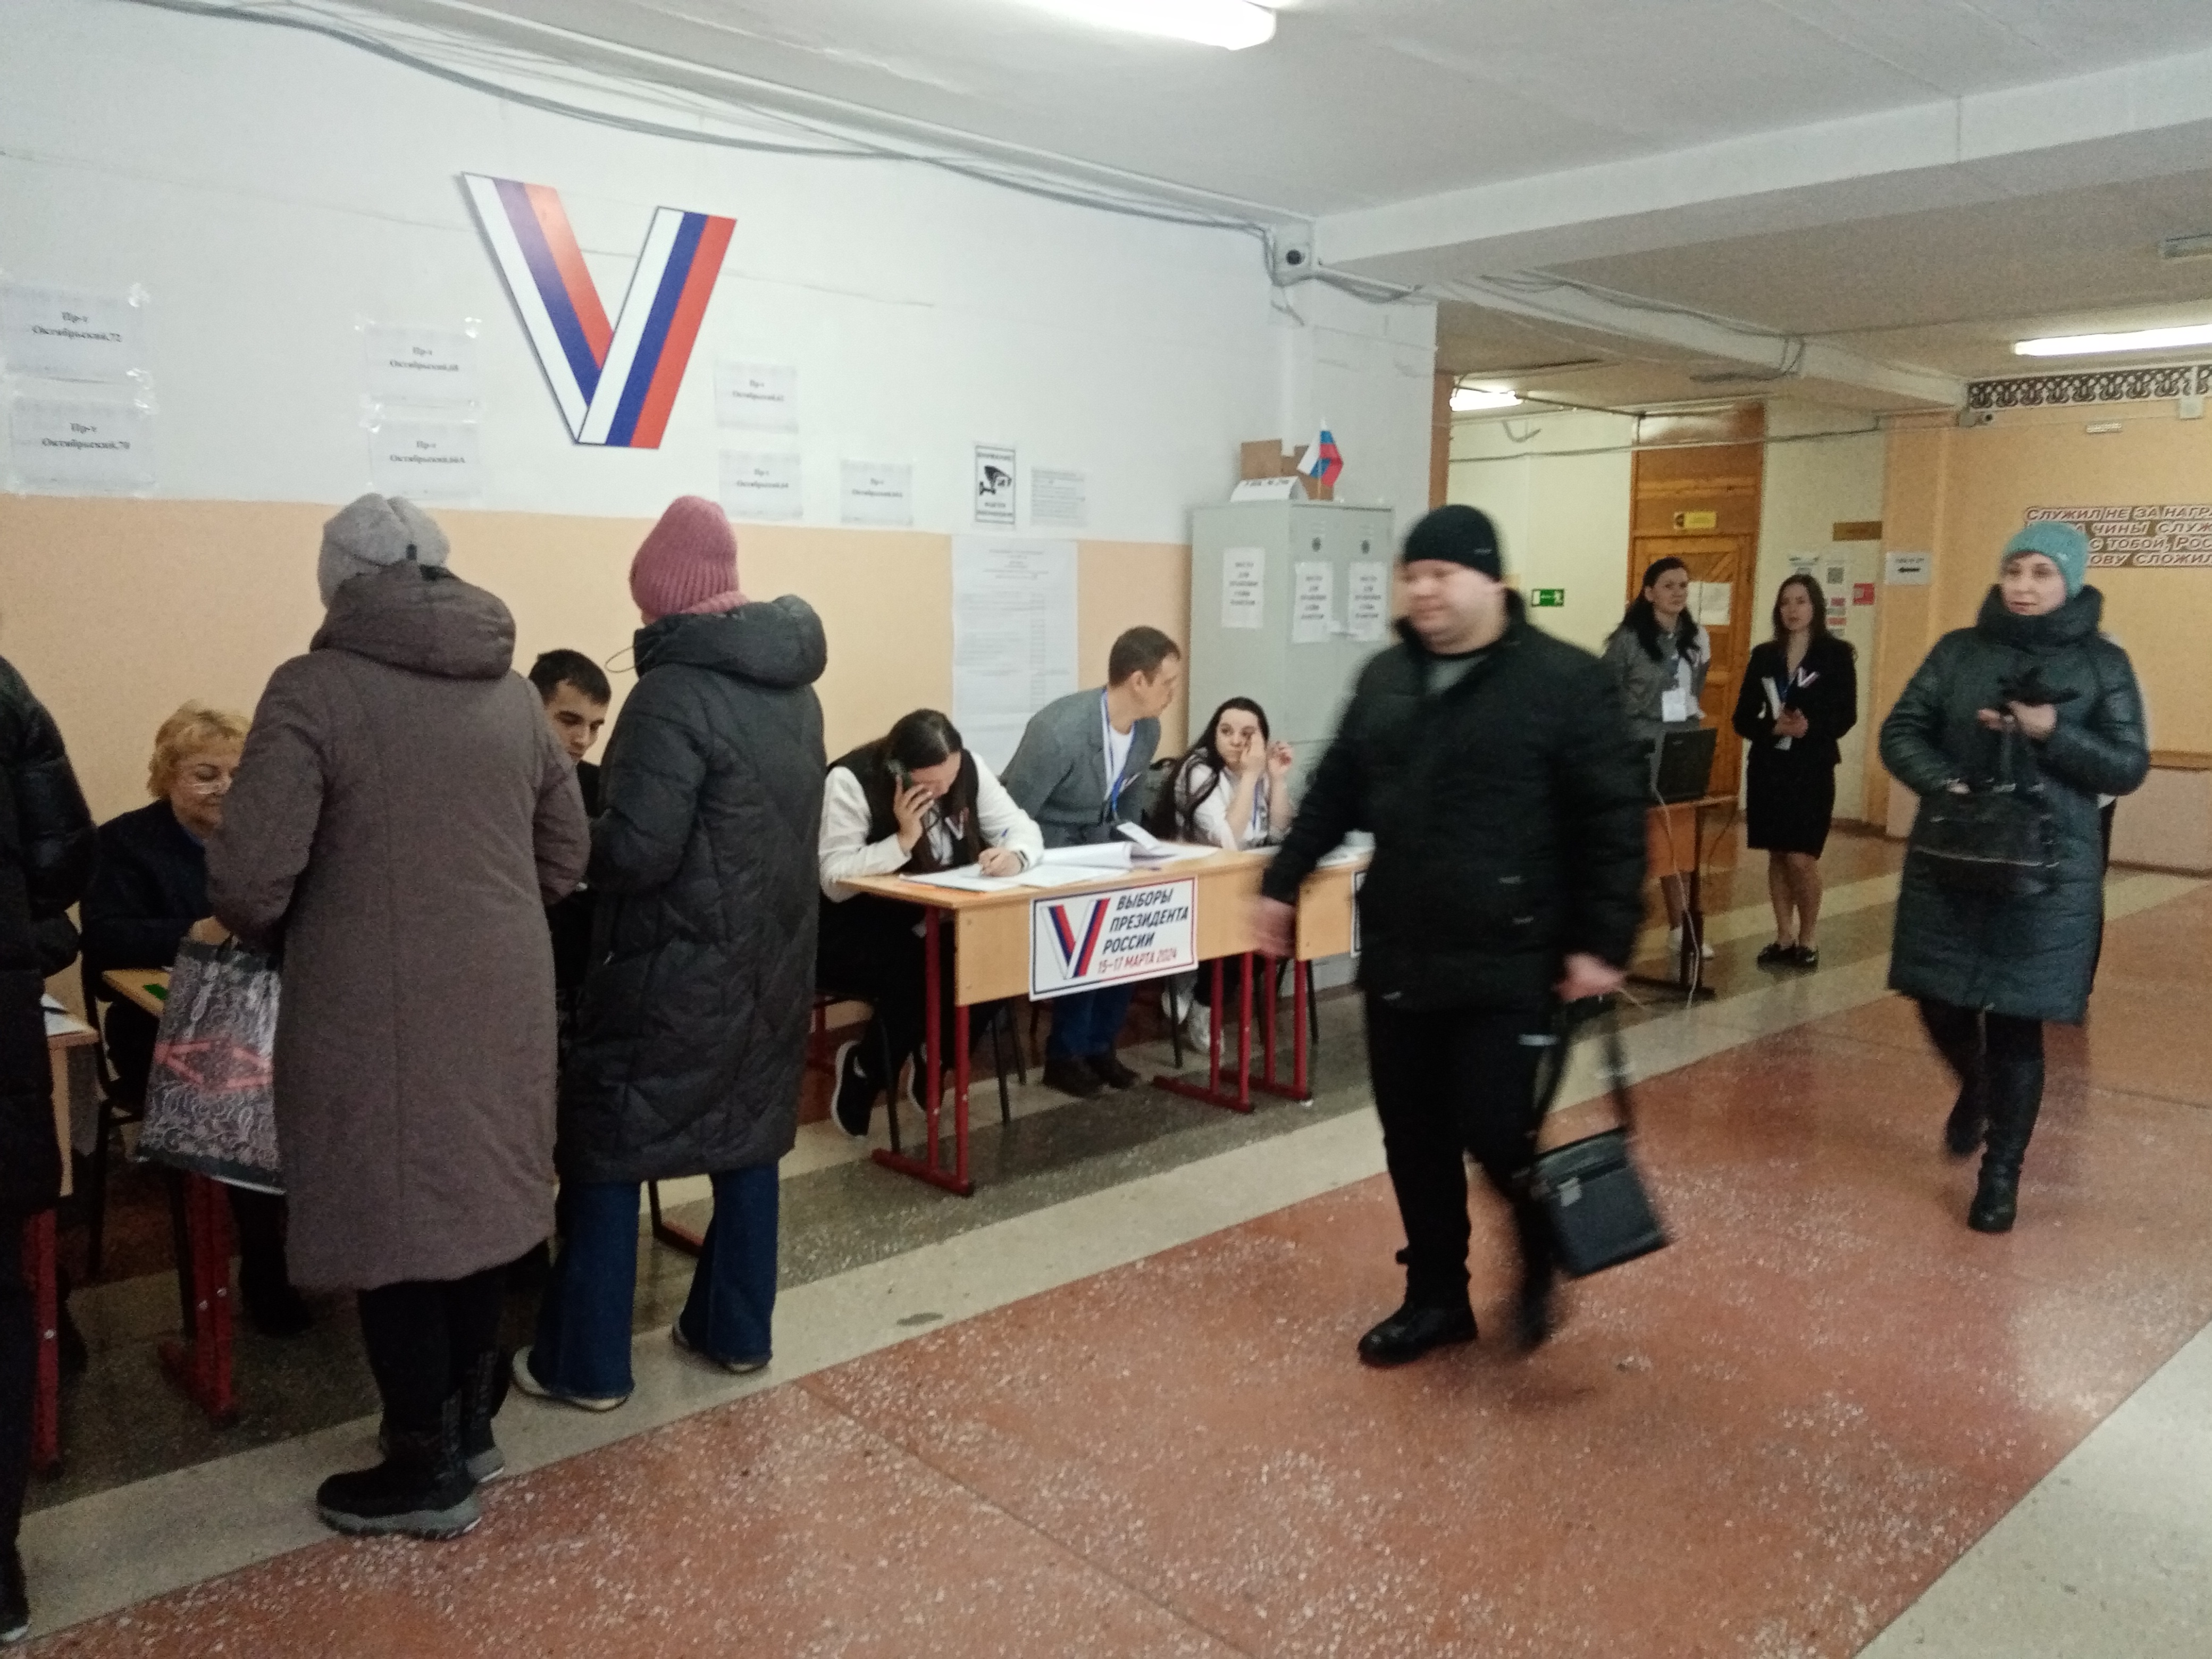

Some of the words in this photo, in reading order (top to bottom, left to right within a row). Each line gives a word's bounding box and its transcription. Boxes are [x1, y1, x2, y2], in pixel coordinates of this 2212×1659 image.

[2027, 509, 2101, 520] СЛУЖИЛ
[2105, 509, 2129, 518] НЕ
[2136, 508, 2157, 517] ЗА
[2163, 507, 2212, 517] НАГР
[2094, 523, 2149, 533] ЧИНЫ
[2091, 555, 2128, 565] ОВУ
[1117, 888, 1174, 911] ВЫБОРЫ
[1110, 906, 1188, 933] ПРЕЗИДЕНТА
[1103, 932, 1155, 954] РОССИИ
[1125, 951, 1154, 969] МАРТА
